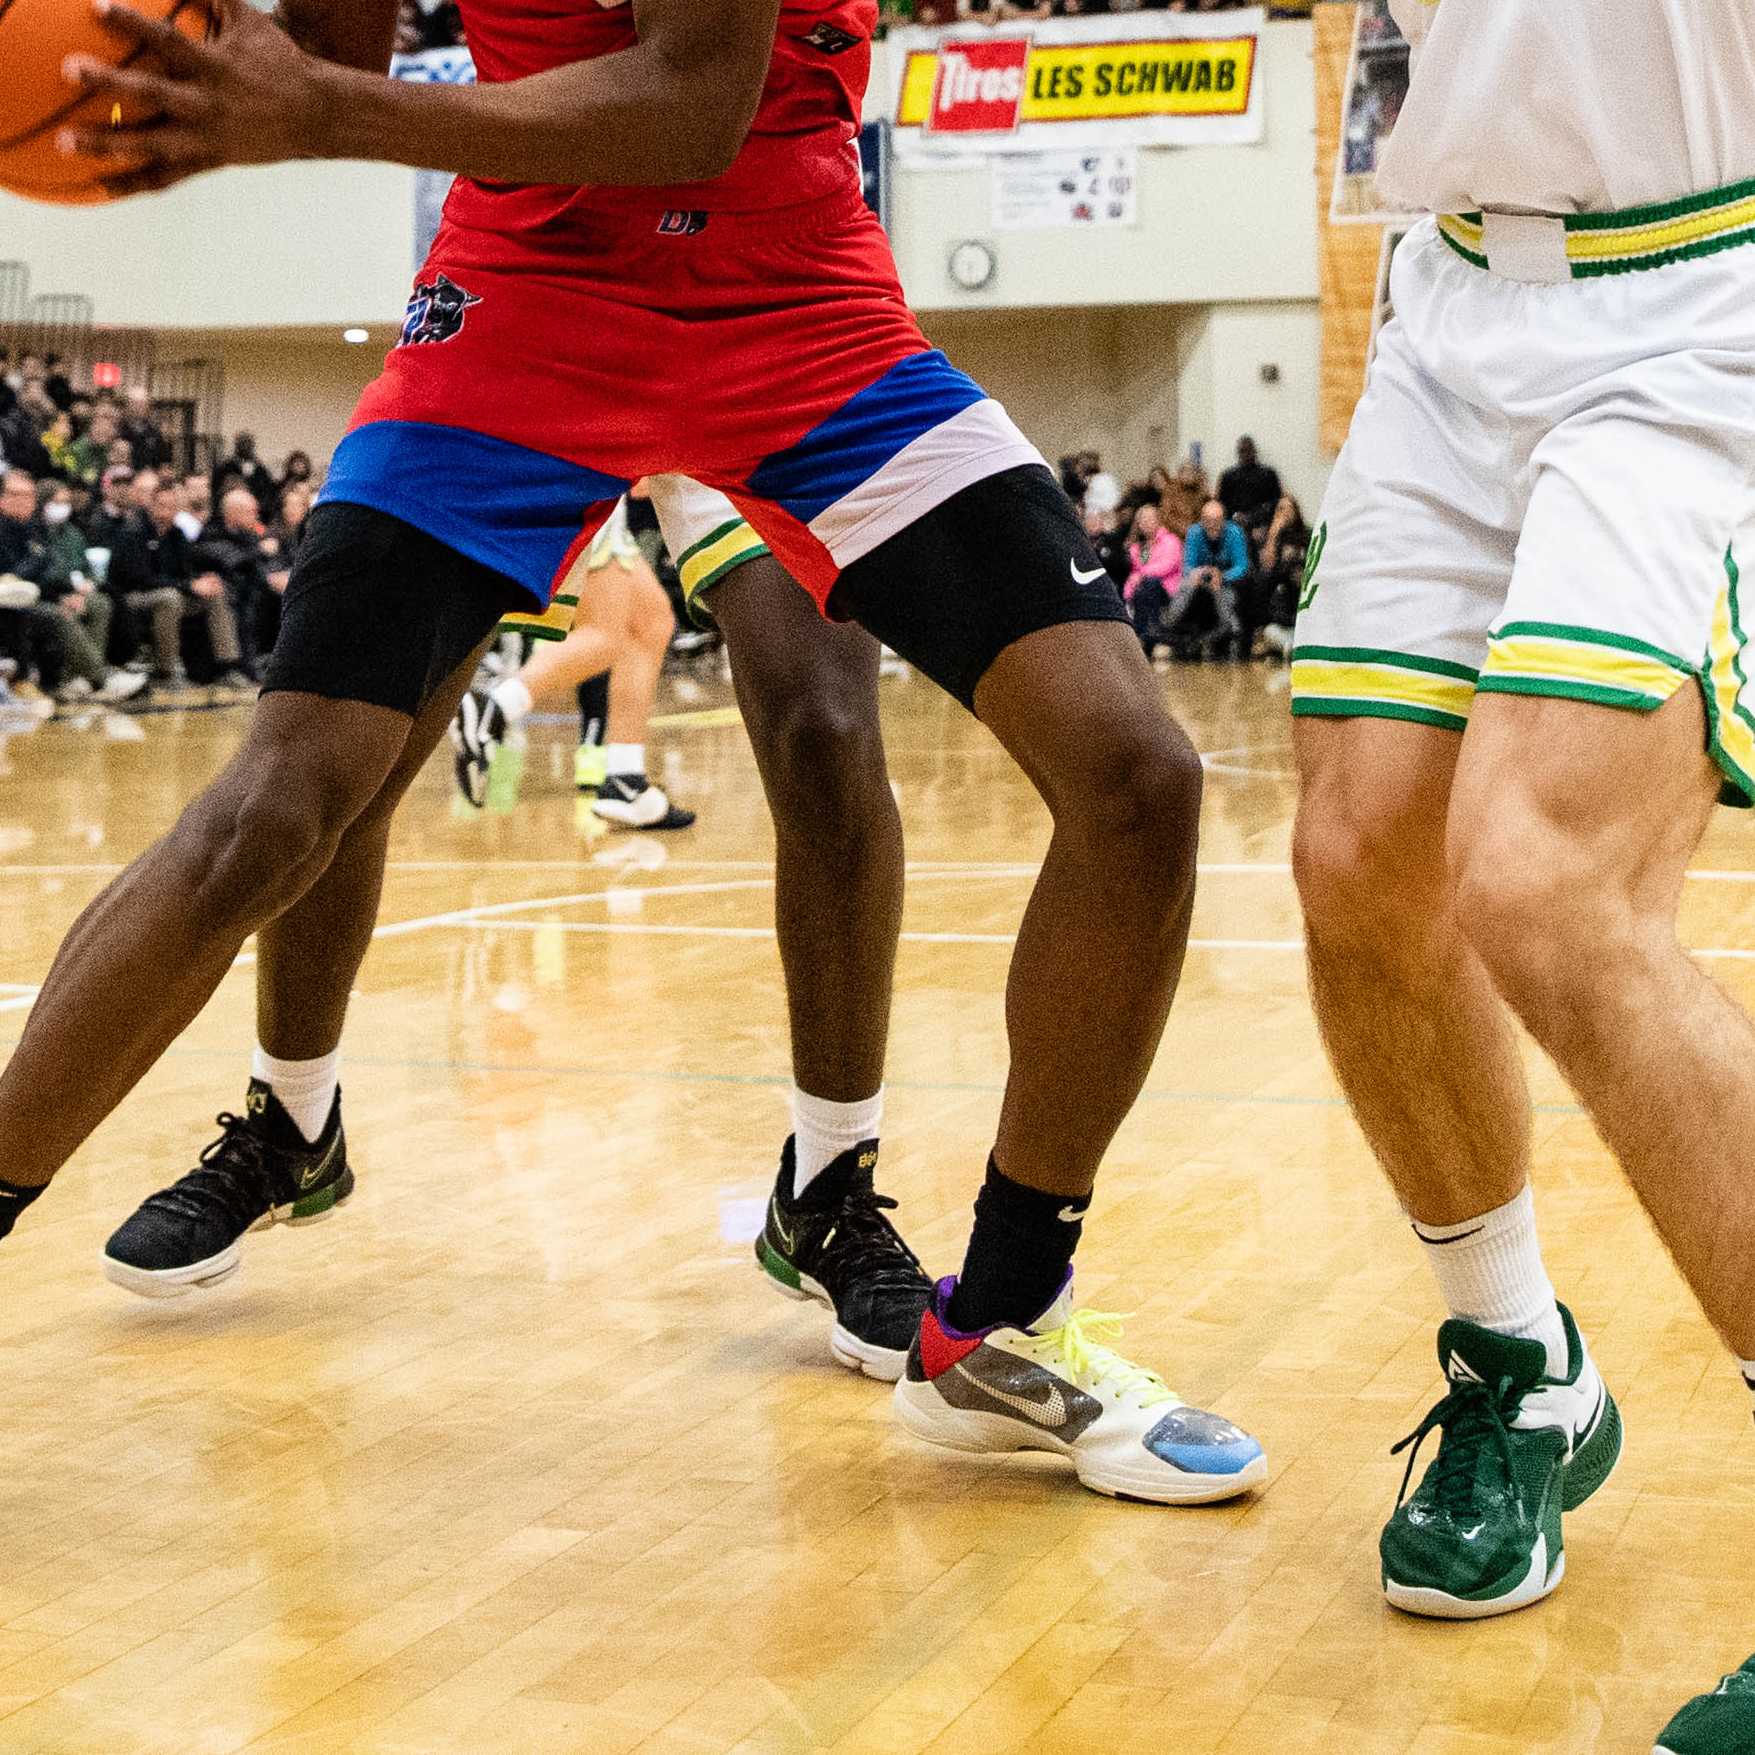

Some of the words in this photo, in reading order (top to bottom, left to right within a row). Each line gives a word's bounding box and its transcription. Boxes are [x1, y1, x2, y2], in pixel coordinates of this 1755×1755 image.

[938, 50, 1022, 113] Tires
[1032, 63, 1085, 100] LES
[1093, 57, 1237, 98] SCHWAB
